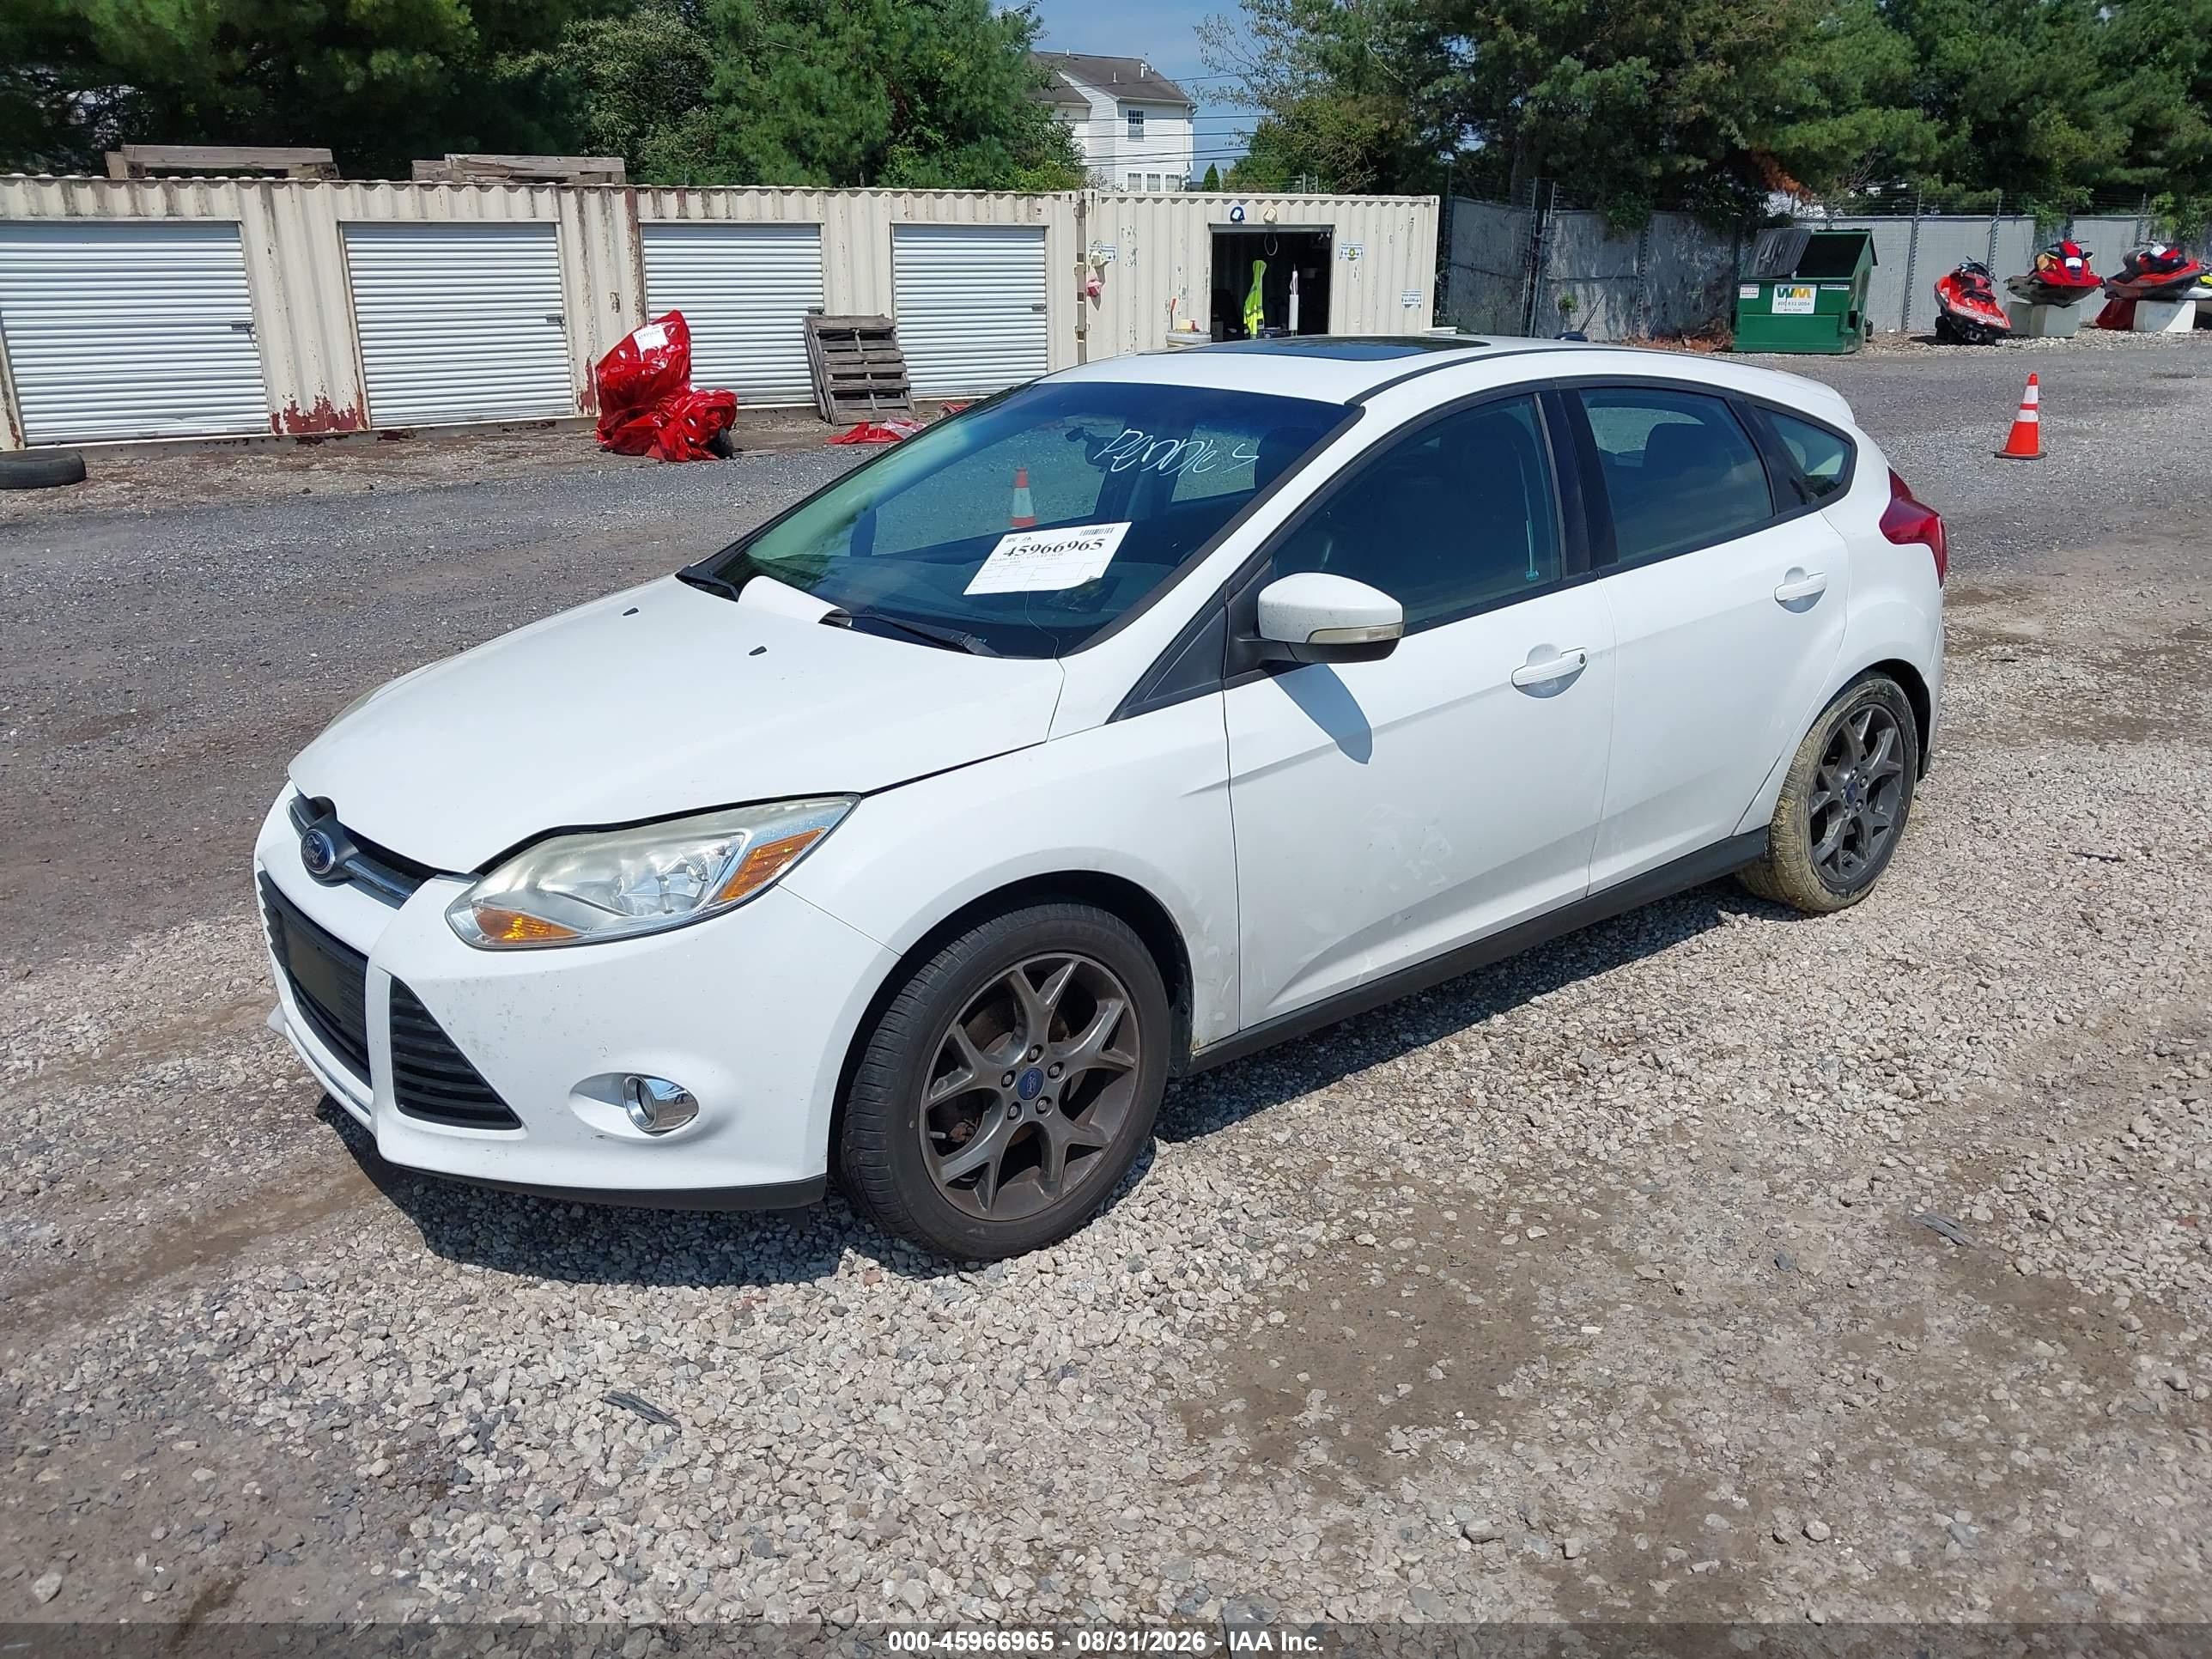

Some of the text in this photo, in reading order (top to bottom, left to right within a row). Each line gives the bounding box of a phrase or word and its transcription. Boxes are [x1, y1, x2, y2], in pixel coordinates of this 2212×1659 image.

[1777, 288, 1811, 298] WM
[1003, 538, 1106, 557] 45966965
[302, 835, 323, 865] Ford
